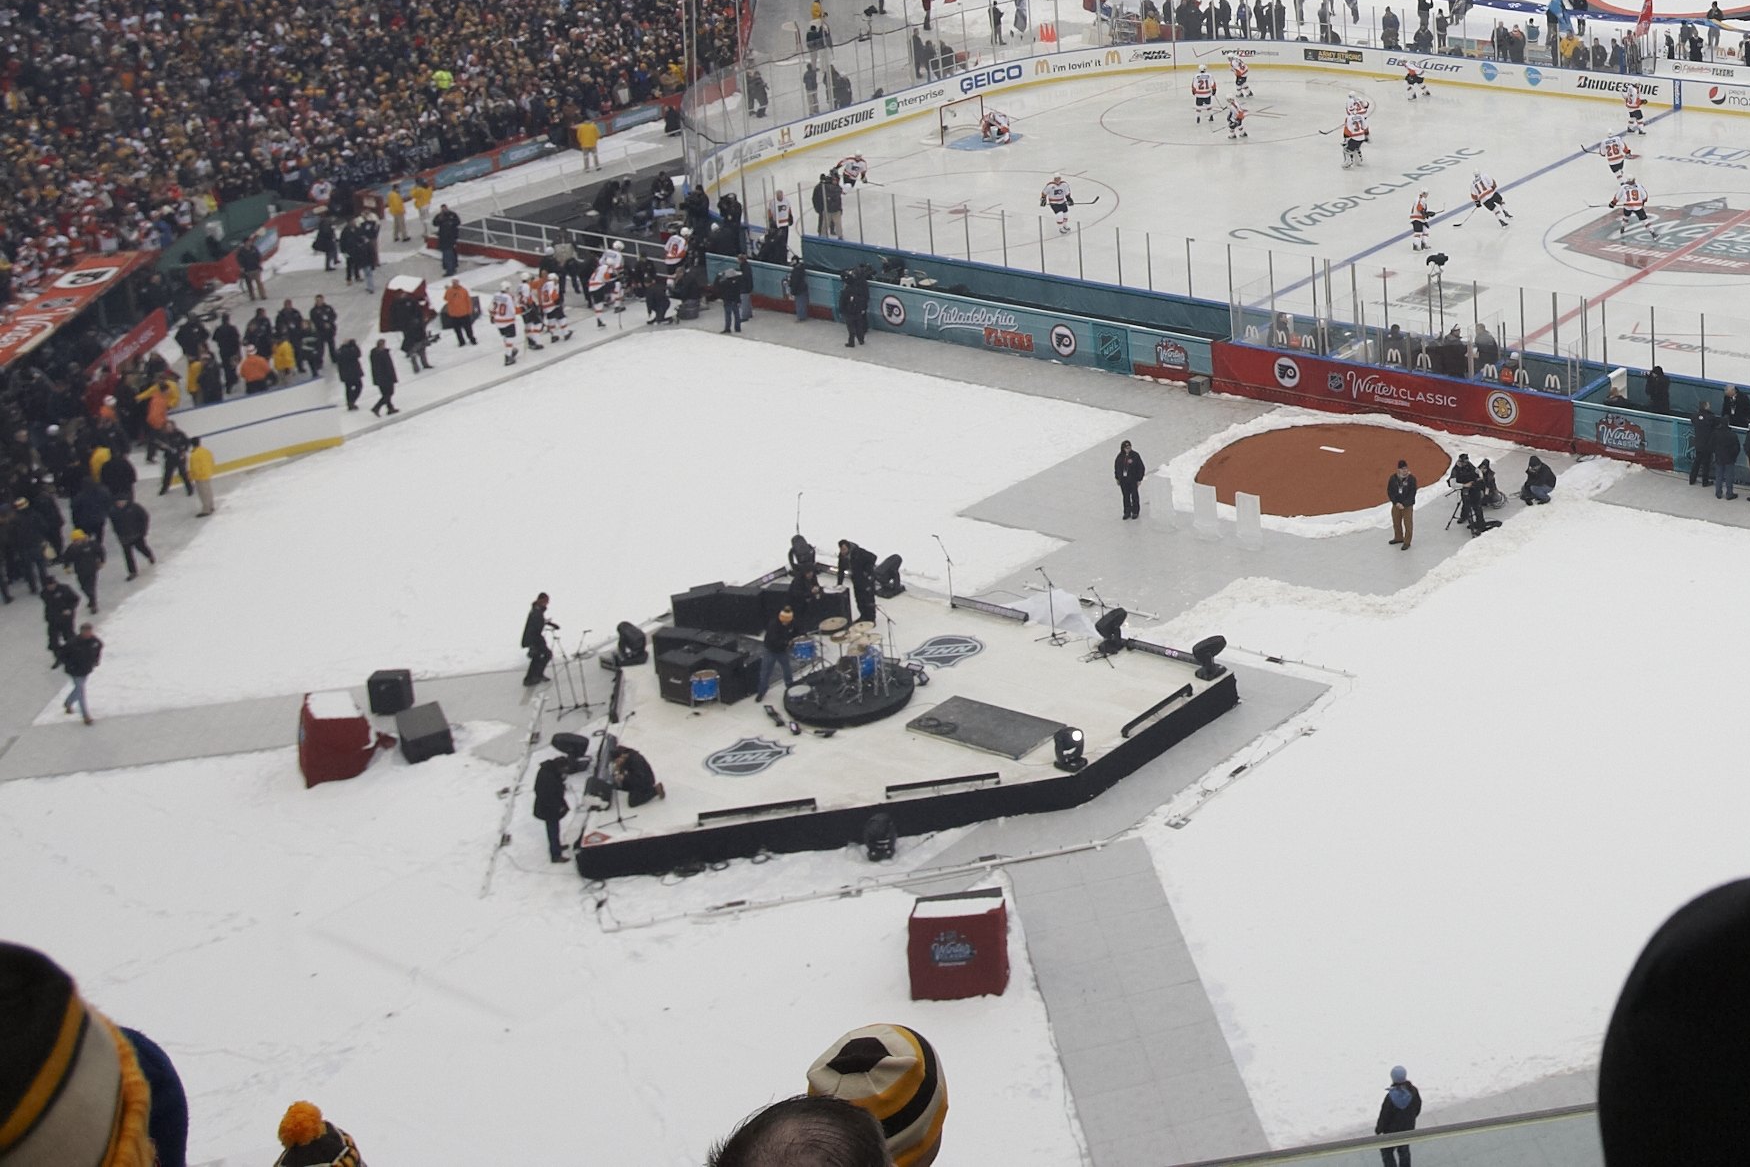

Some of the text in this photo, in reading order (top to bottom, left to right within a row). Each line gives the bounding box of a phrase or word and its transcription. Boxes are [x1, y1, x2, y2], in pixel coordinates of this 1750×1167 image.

[1053, 59, 1101, 73] i'm lovin' it
[1712, 68, 1734, 77] FLYERS
[960, 64, 1023, 94] GEICO
[1197, 79, 1210, 91] 21
[1577, 74, 1659, 96] BRIDGESNE
[885, 87, 945, 111] enterprise
[804, 107, 875, 140] BRIDGESTONE
[1605, 143, 1620, 156] 26
[1656, 154, 1749, 170] HONDA
[1475, 179, 1488, 194] 11
[1625, 189, 1639, 202] 19
[1228, 147, 1485, 245] Winter CLASSIC
[923, 299, 1018, 332] Philadelphia
[1102, 338, 1120, 356] NHL
[1157, 344, 1189, 363] Winter
[1346, 370, 1457, 409] Winter CLASSIC
[1599, 423, 1642, 445] Winter
[1606, 438, 1640, 450] CLASSIC
[720, 750, 773, 765] NHL
[931, 942, 973, 961] Winter
